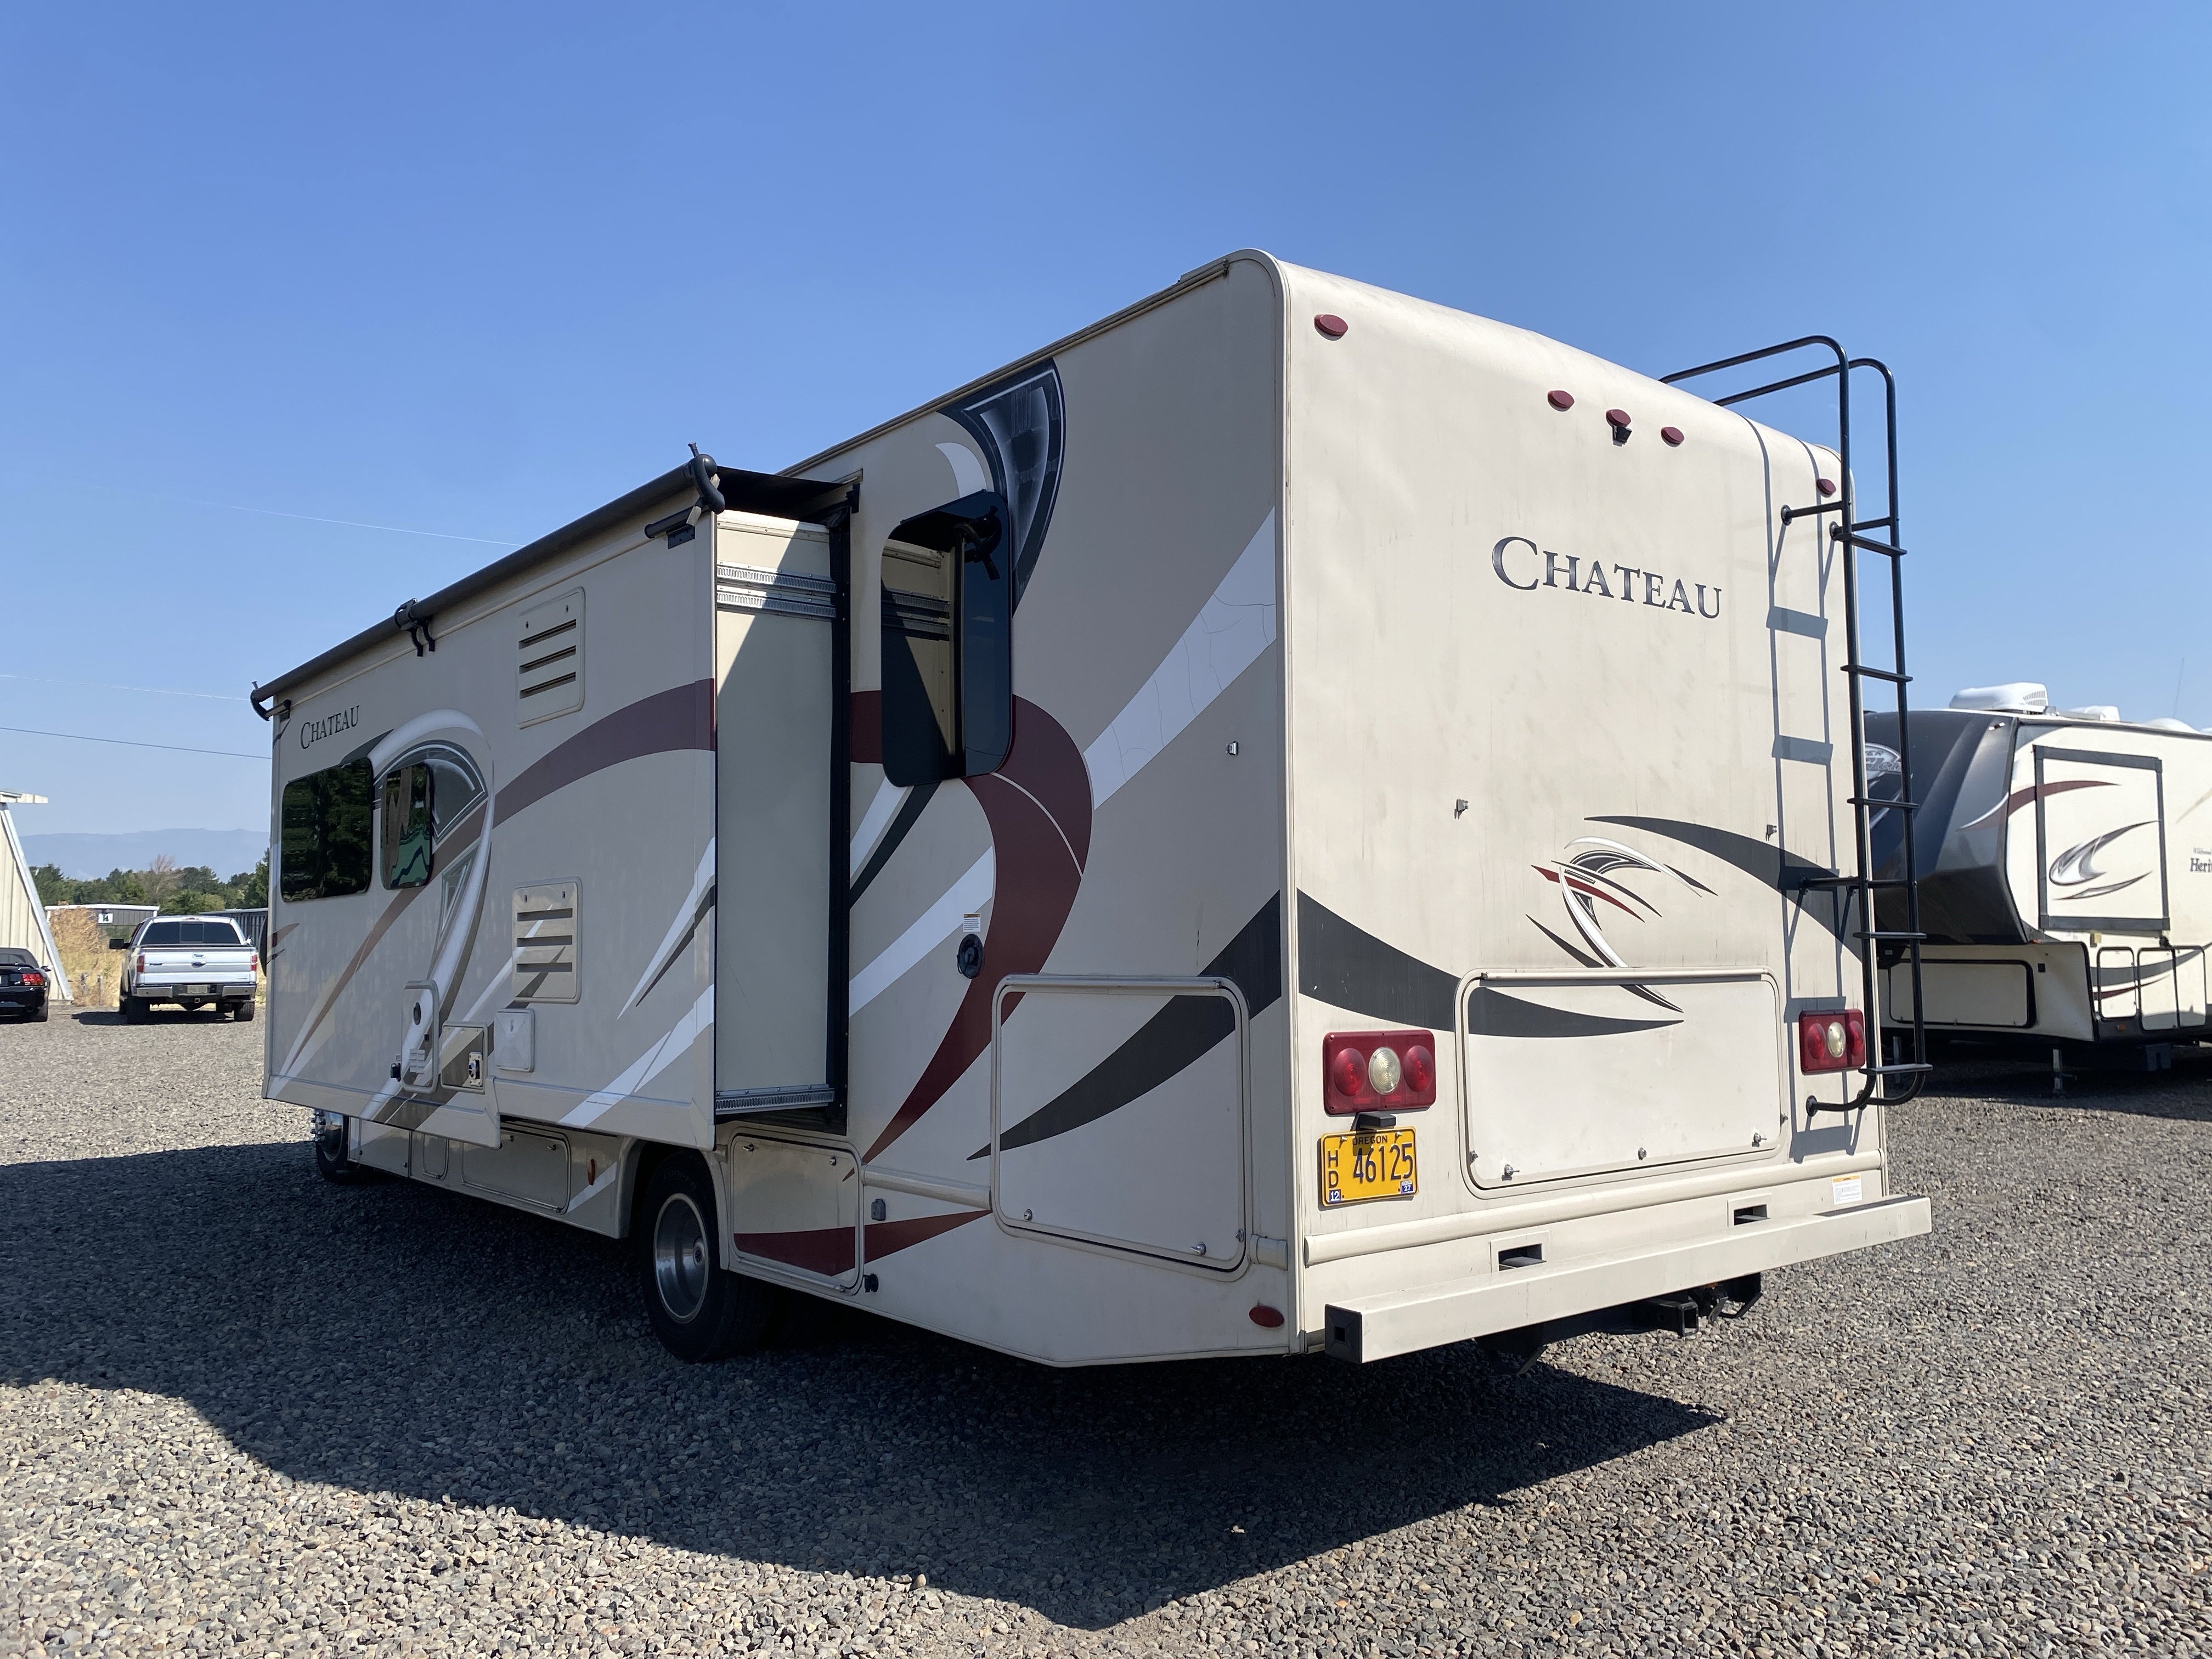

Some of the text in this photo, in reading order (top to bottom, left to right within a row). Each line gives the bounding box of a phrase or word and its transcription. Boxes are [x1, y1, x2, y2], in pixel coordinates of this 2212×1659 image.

[1491, 535, 1722, 619] CHATEAU
[300, 705, 360, 749] CHATEAU
[2190, 857, 2212, 872] Heri
[1352, 1135, 1388, 1146] OREGON
[1353, 1143, 1414, 1184] 46125
[1330, 1190, 1340, 1201] 12
